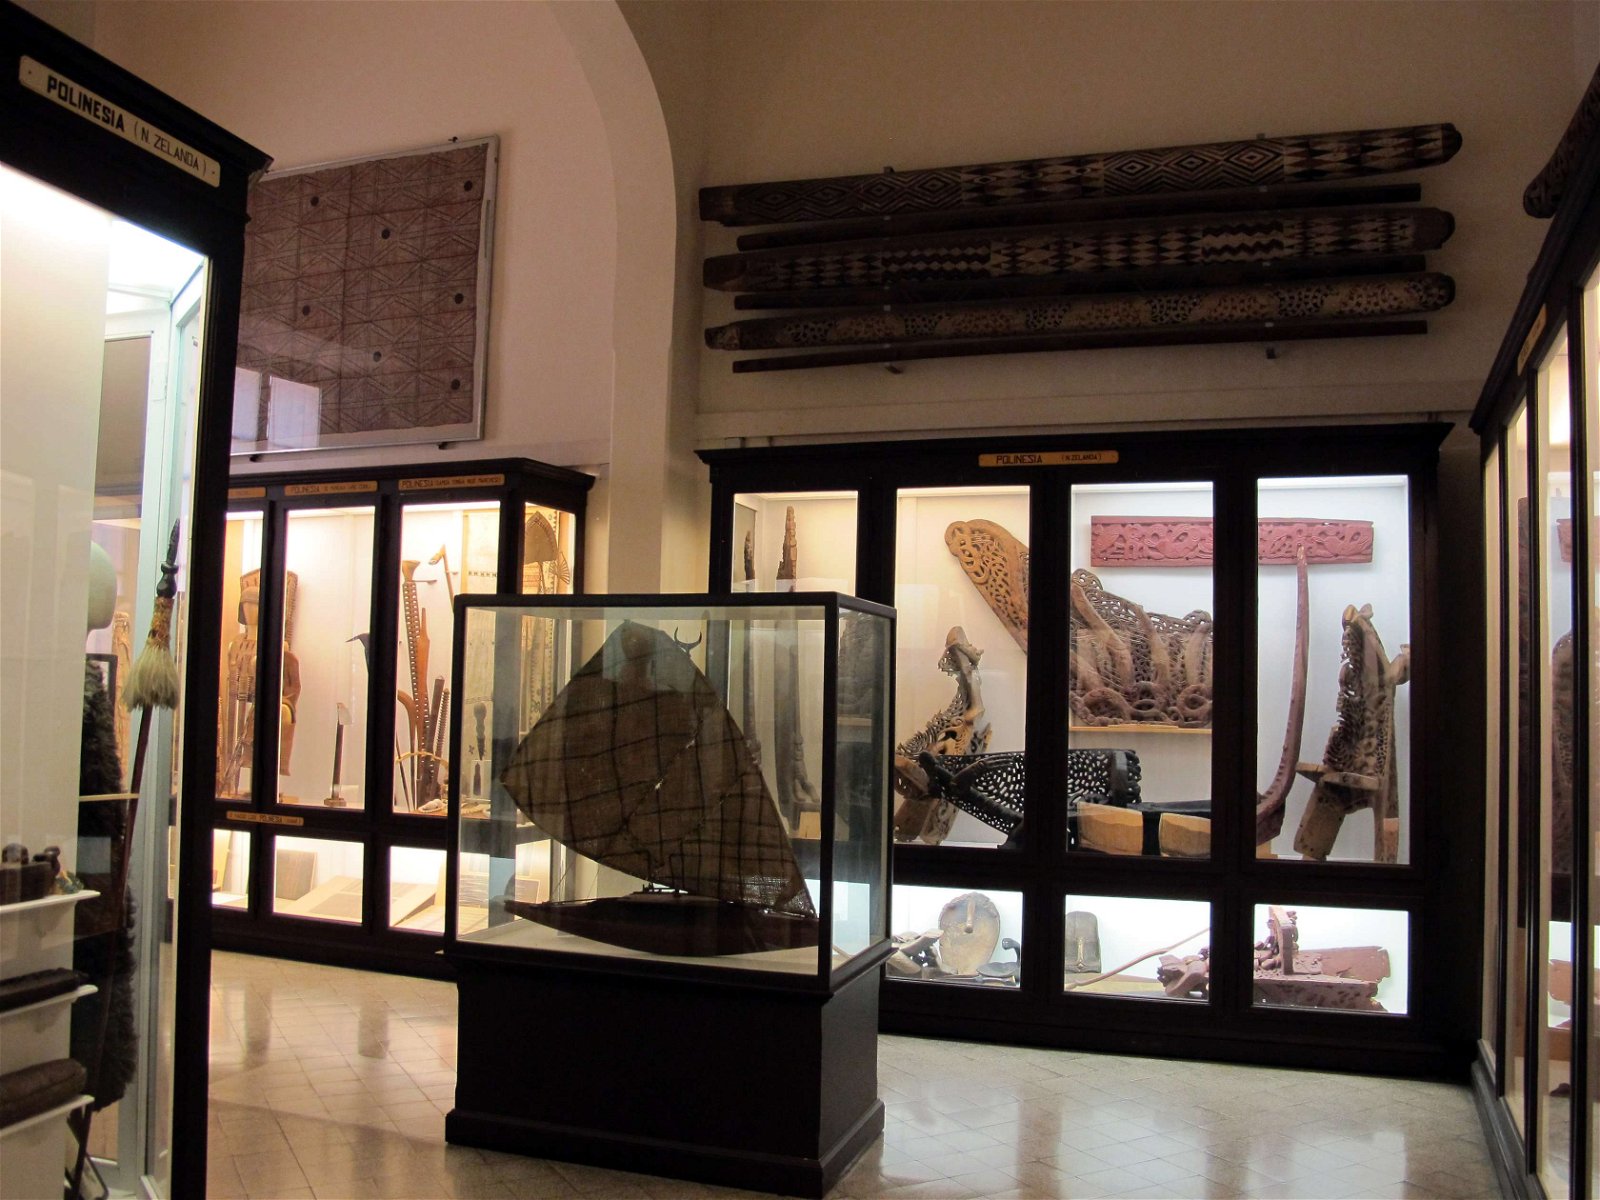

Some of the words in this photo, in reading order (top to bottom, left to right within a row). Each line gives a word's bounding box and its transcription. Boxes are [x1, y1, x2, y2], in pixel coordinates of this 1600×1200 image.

[47, 75, 125, 133] POLINESIA
[995, 455, 1043, 465] POLINESIA
[401, 479, 433, 489] POLINESIA
